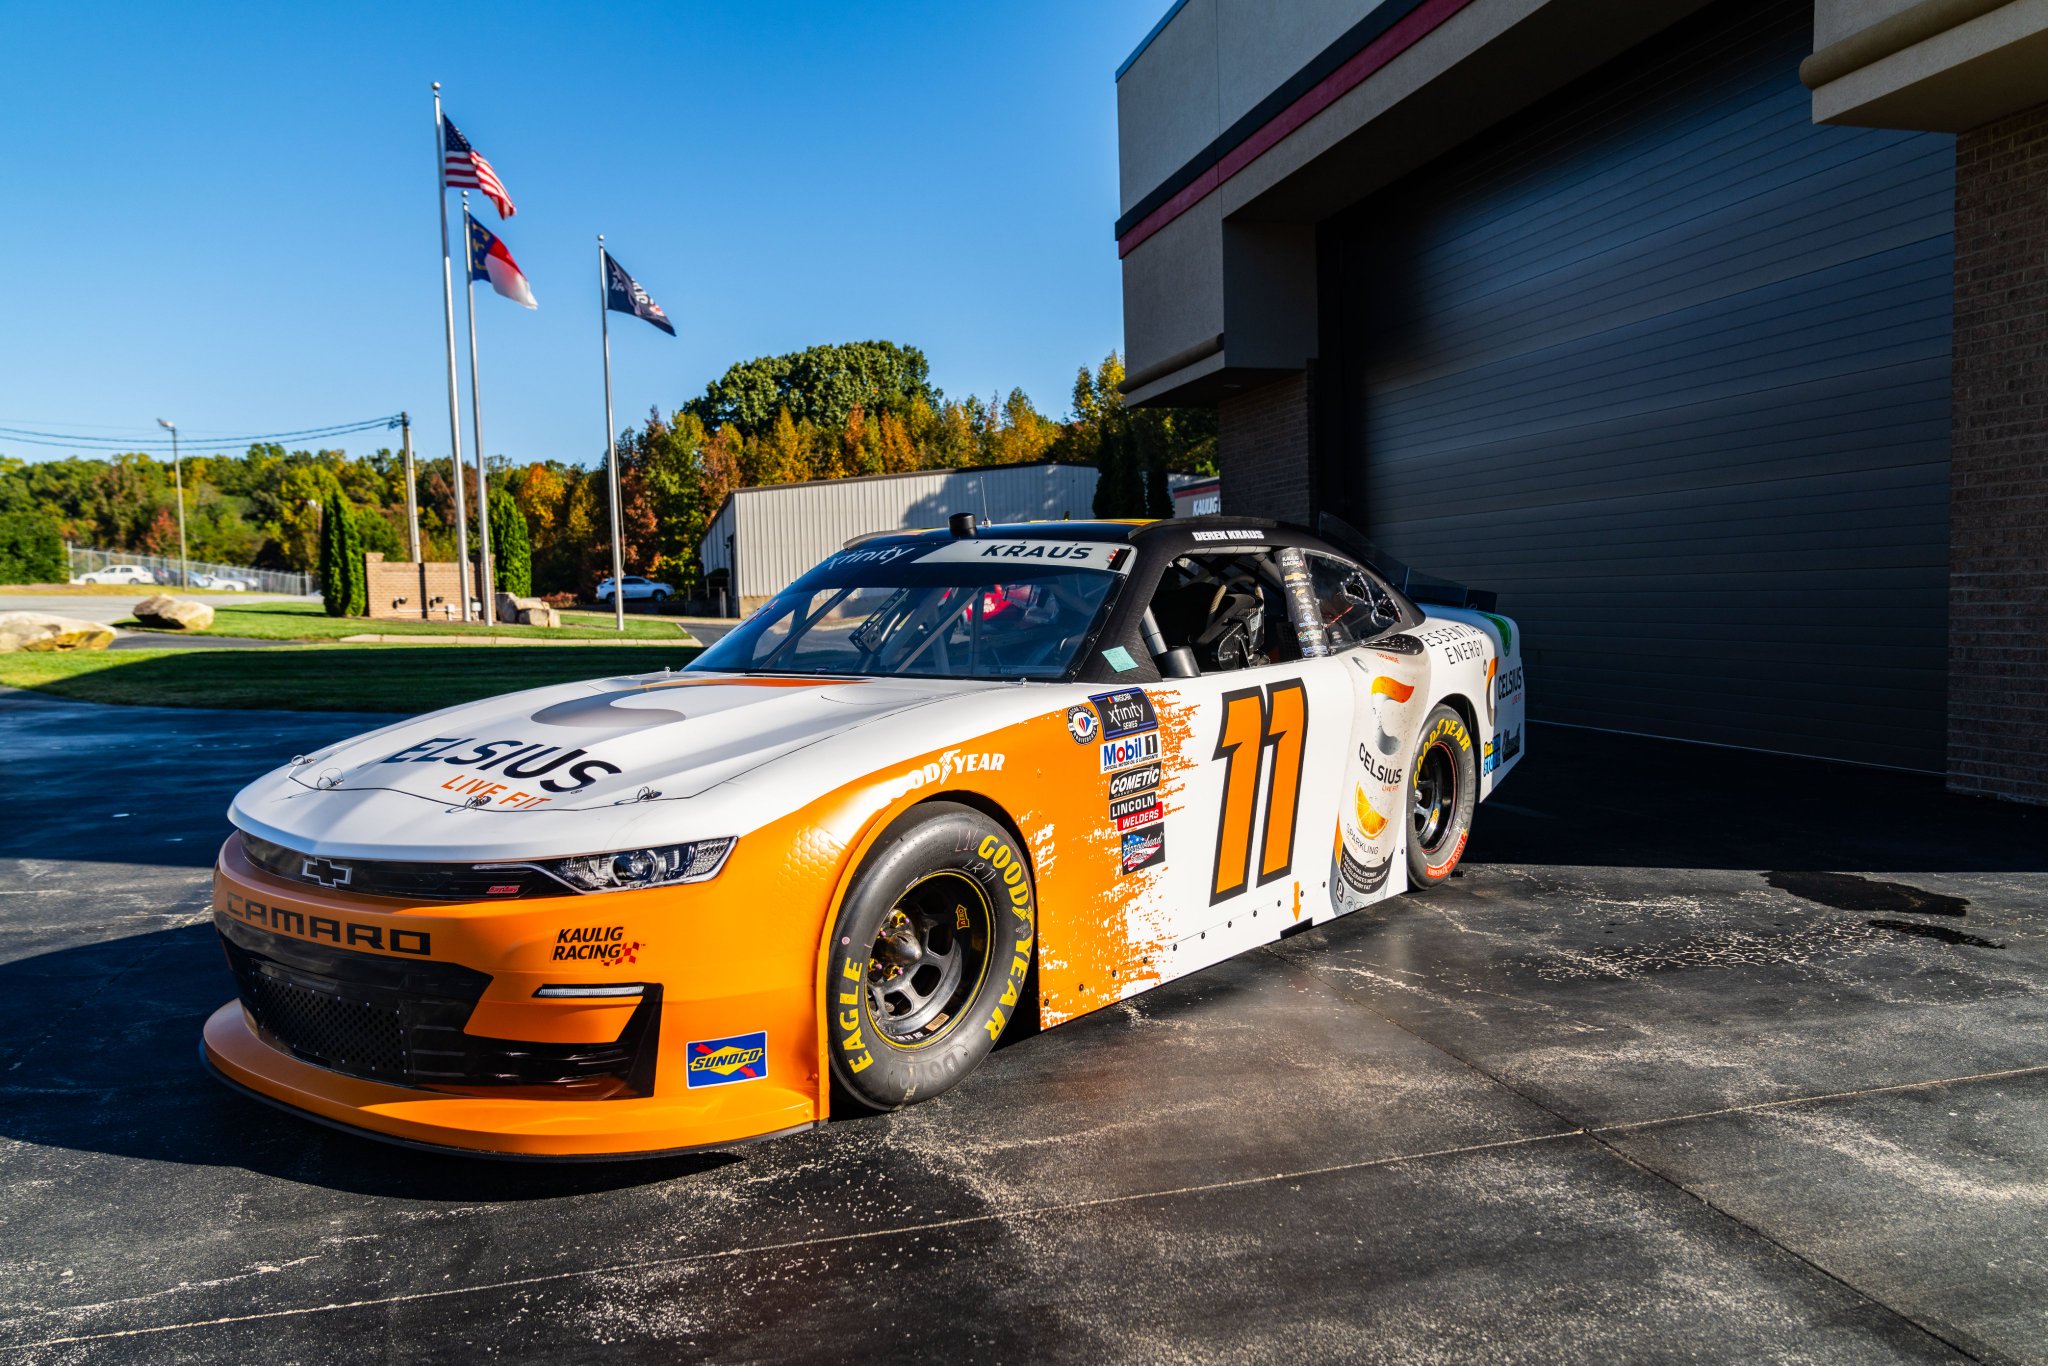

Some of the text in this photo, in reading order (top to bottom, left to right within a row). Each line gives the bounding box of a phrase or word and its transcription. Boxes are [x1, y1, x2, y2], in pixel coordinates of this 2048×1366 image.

[1192, 530, 1264, 541] DEREK KRAUS
[827, 547, 916, 570] xfinity
[981, 545, 1092, 559] KRAUS
[1418, 624, 1484, 648] ESSENTIAL
[1444, 639, 1484, 665] ENERGY
[1498, 666, 1522, 701] CELSIUS
[1108, 702, 1144, 726] xfinity
[1123, 720, 1138, 730] SERIES
[1103, 737, 1142, 766] Mobil
[1358, 742, 1402, 784] CELSIUS
[1413, 718, 1471, 788] GOODYEAR
[372, 737, 622, 794] ELSIUS
[441, 775, 552, 809] LIVE FIT
[1111, 768, 1159, 795] COMETIC
[1209, 677, 1309, 907] 11
[1112, 795, 1154, 817] LINCOLN
[1122, 809, 1159, 828] WELDERS
[1346, 823, 1379, 855] SPARKLING
[227, 891, 430, 956] CAMARO
[958, 908, 966, 925] AERO
[557, 926, 624, 943] KAULIG
[978, 835, 1034, 1041] GOODYEAR
[552, 944, 621, 960] RACING
[840, 957, 874, 1074] EAGLE
[693, 1049, 760, 1070] SUNOCO
